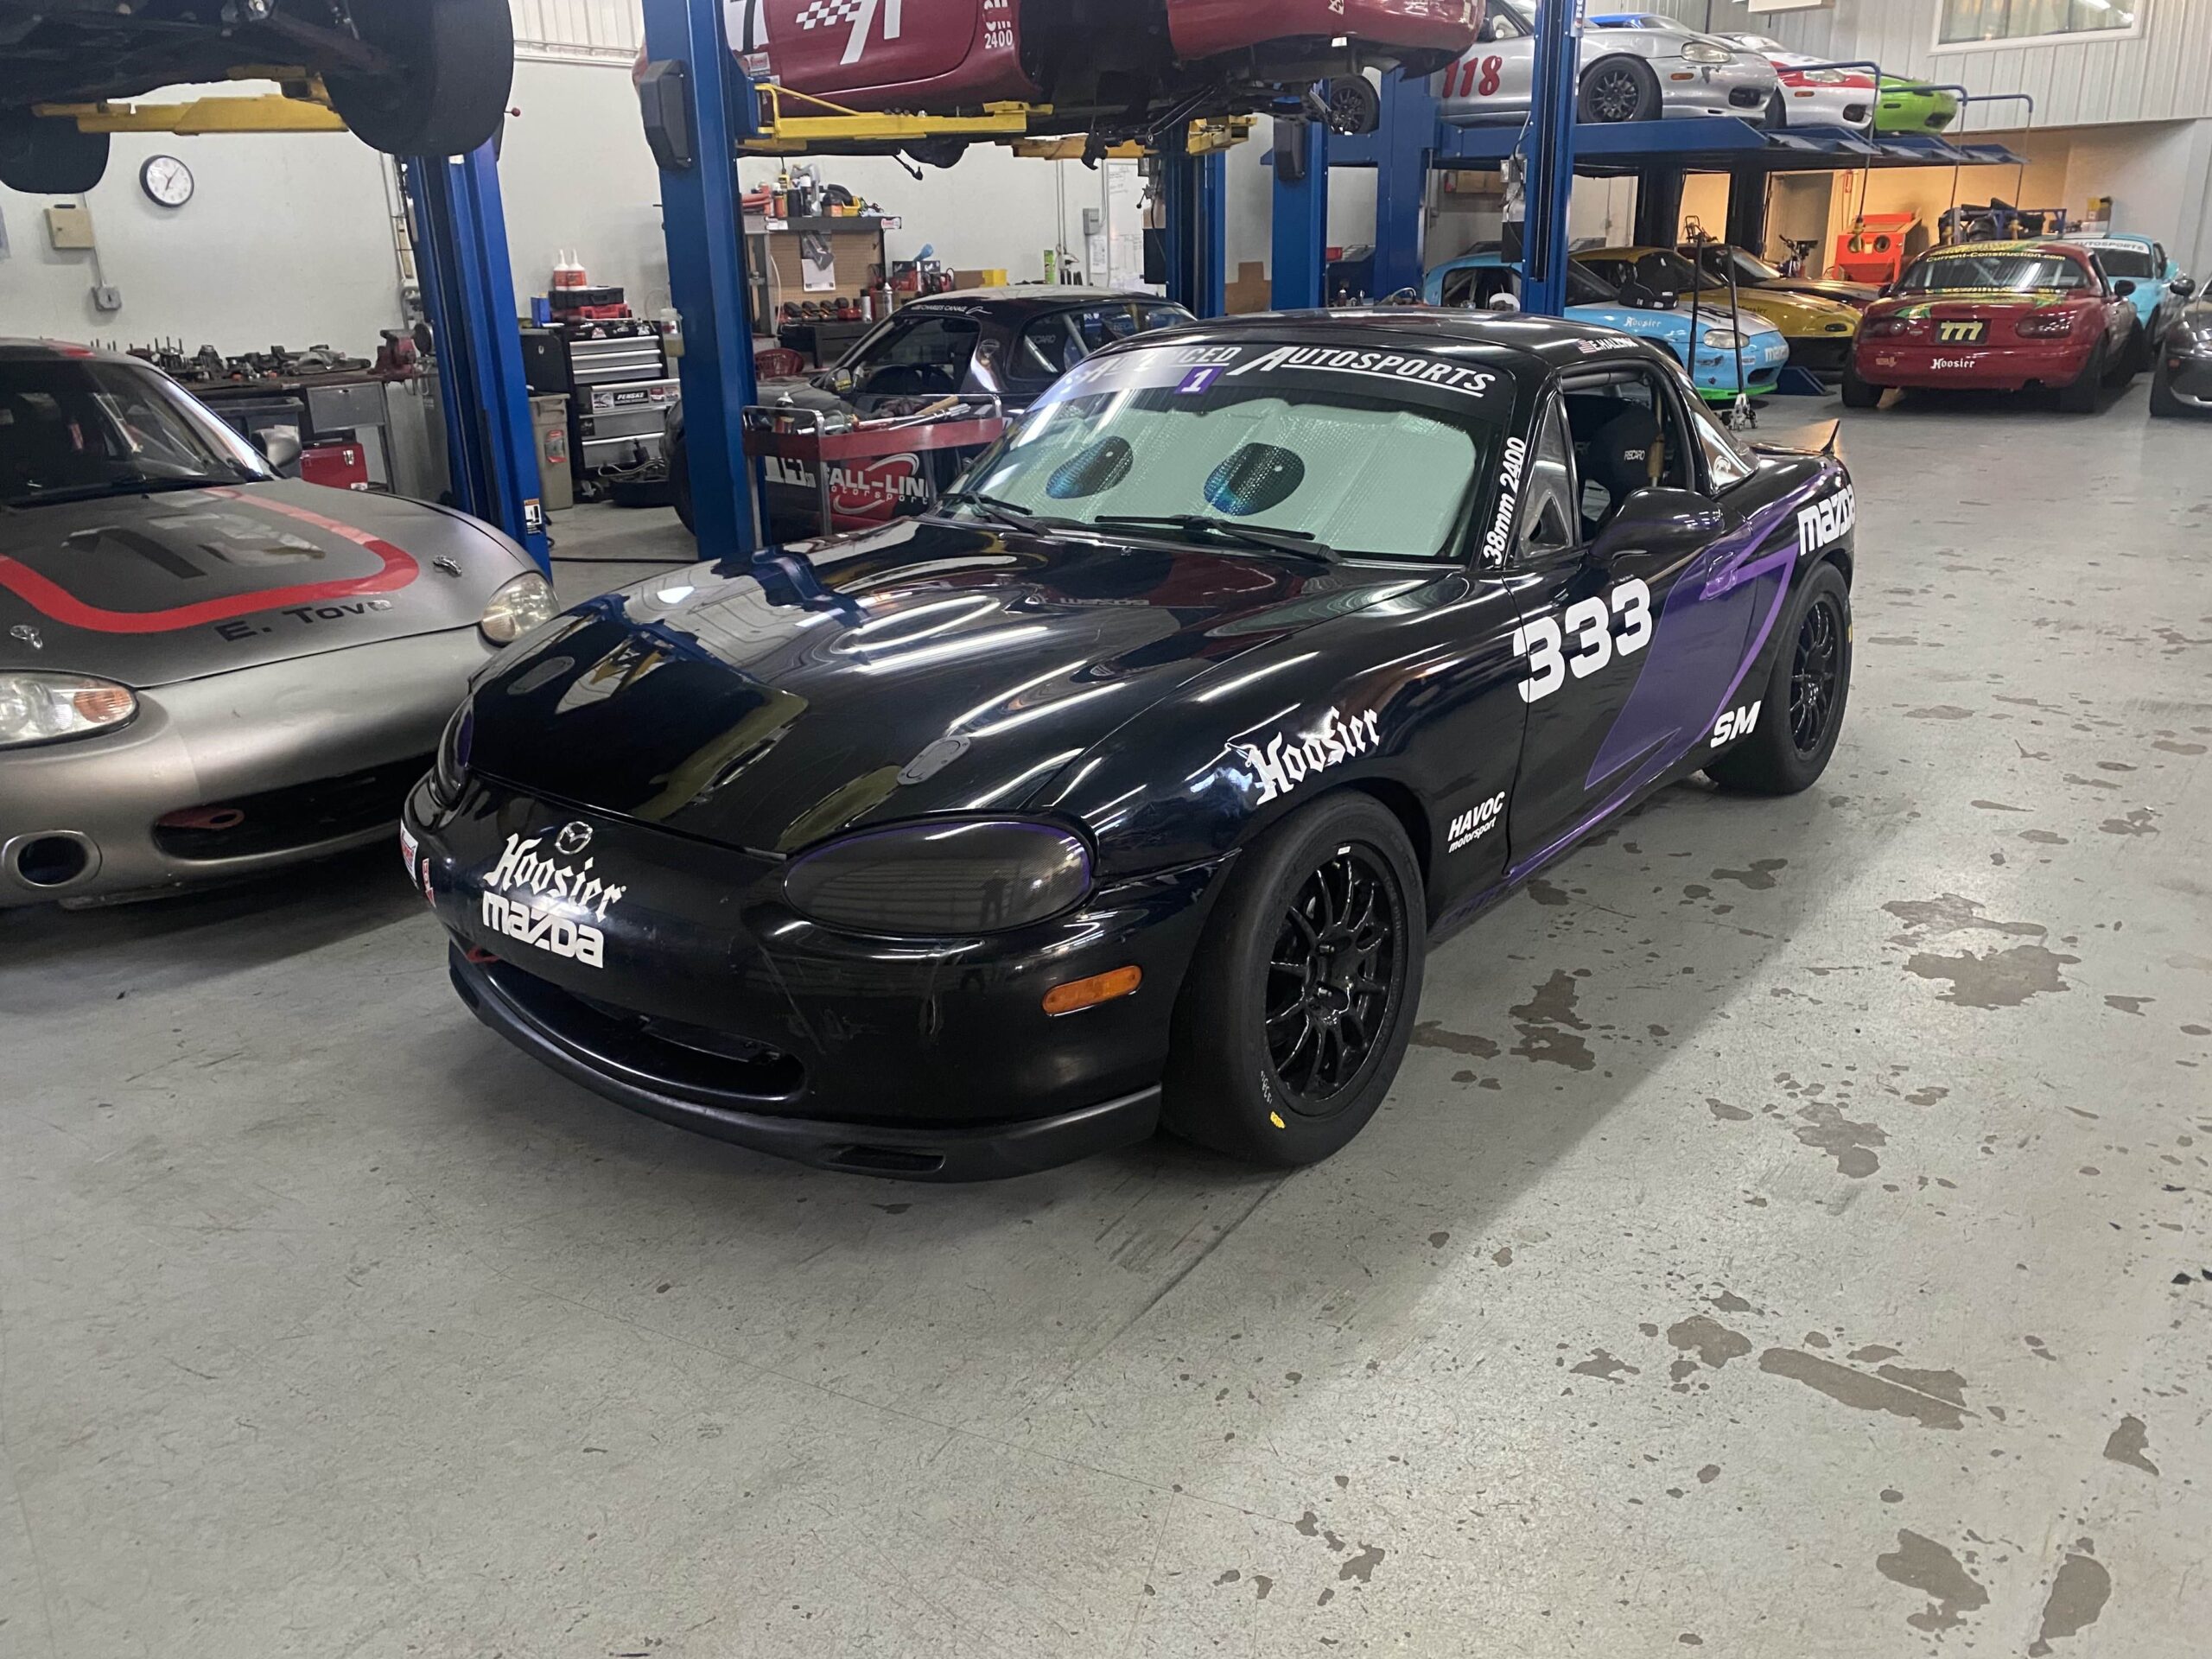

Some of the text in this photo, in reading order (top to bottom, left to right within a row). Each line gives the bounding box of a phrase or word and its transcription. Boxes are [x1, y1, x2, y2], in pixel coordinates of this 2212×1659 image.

[984, 29, 1013, 49] 2400
[1442, 55, 1503, 99] 118
[1624, 316, 1662, 328] Hoosier
[1941, 321, 1983, 341] 777
[1180, 368, 1214, 394] 1
[1226, 346, 1497, 393] AUTOSPORTS
[1930, 357, 1976, 371] Hoosier
[827, 467, 929, 499] ALL-LIN
[830, 485, 928, 505] otorsport
[1483, 436, 1527, 565] 38mm 2400
[214, 620, 272, 643] E.
[1513, 578, 1653, 704] 333
[1711, 700, 1762, 748] SM
[1245, 705, 1380, 805] Hoosier
[1447, 791, 1505, 842] HAVOC
[1448, 816, 1497, 854] motorsport
[483, 833, 626, 923] Hoosier
[482, 891, 604, 969] mazda
